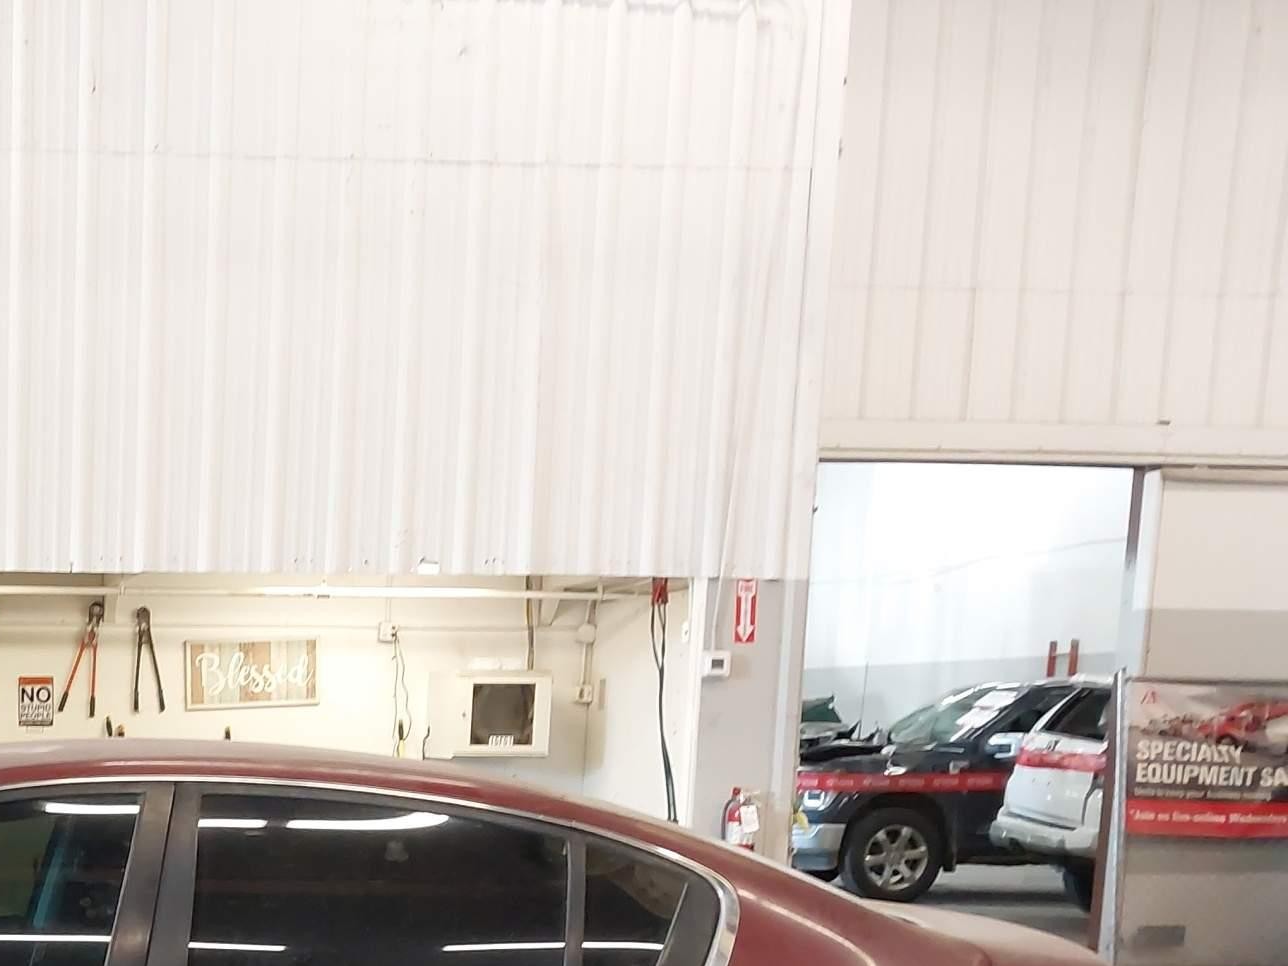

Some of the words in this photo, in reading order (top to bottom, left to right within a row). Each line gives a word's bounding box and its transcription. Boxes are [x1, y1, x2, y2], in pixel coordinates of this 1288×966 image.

[195, 651, 314, 696] Blessed
[21, 686, 51, 703] NO
[1135, 739, 1243, 764] SPECIALTY
[1135, 762, 1258, 787] EQUIPMENT
